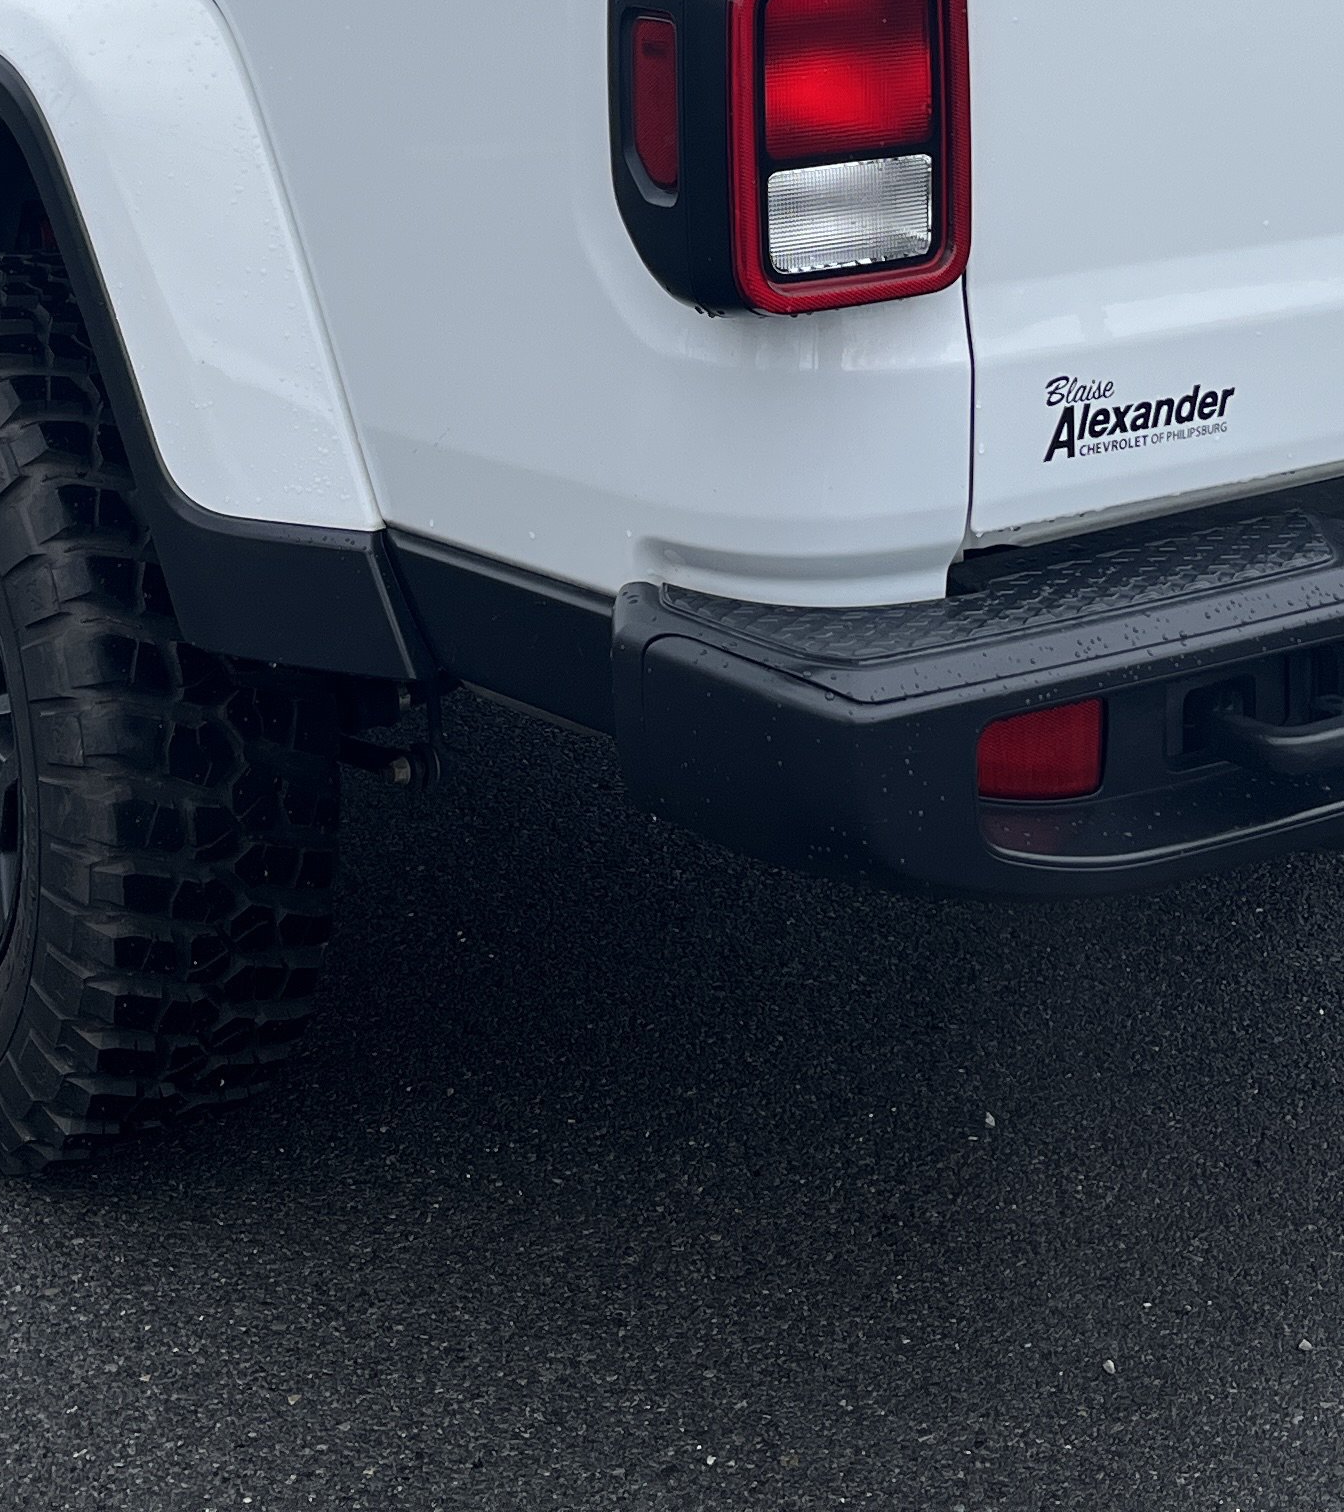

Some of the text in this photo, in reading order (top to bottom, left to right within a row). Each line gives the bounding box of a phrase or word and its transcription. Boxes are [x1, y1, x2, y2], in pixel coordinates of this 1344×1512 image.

[1045, 375, 1115, 407] Blaise
[1043, 384, 1236, 463] Alexander
[1079, 421, 1228, 457] CHEVROLET OF PHILIPSBURG
